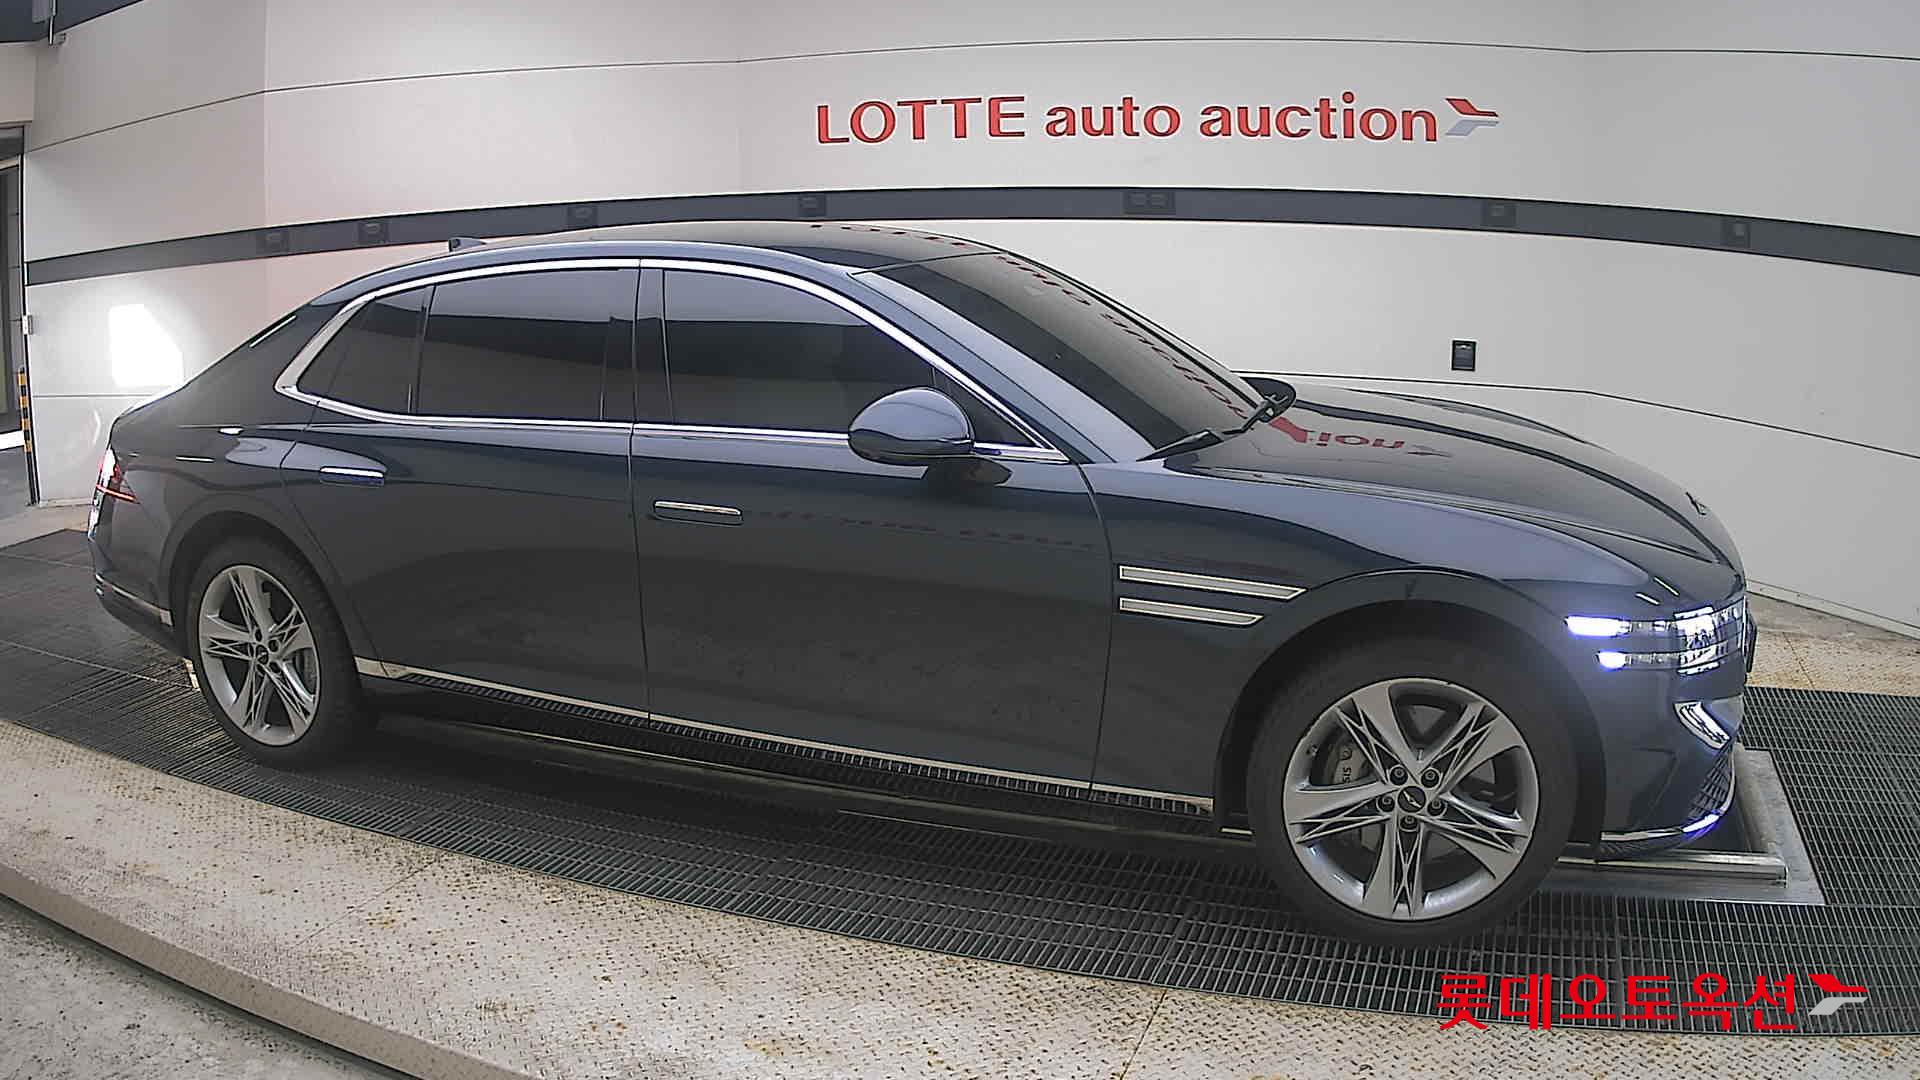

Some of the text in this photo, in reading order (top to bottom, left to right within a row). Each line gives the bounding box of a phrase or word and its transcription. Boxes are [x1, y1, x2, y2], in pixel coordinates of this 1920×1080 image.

[816, 92, 1438, 144] LOTTE auto auction
